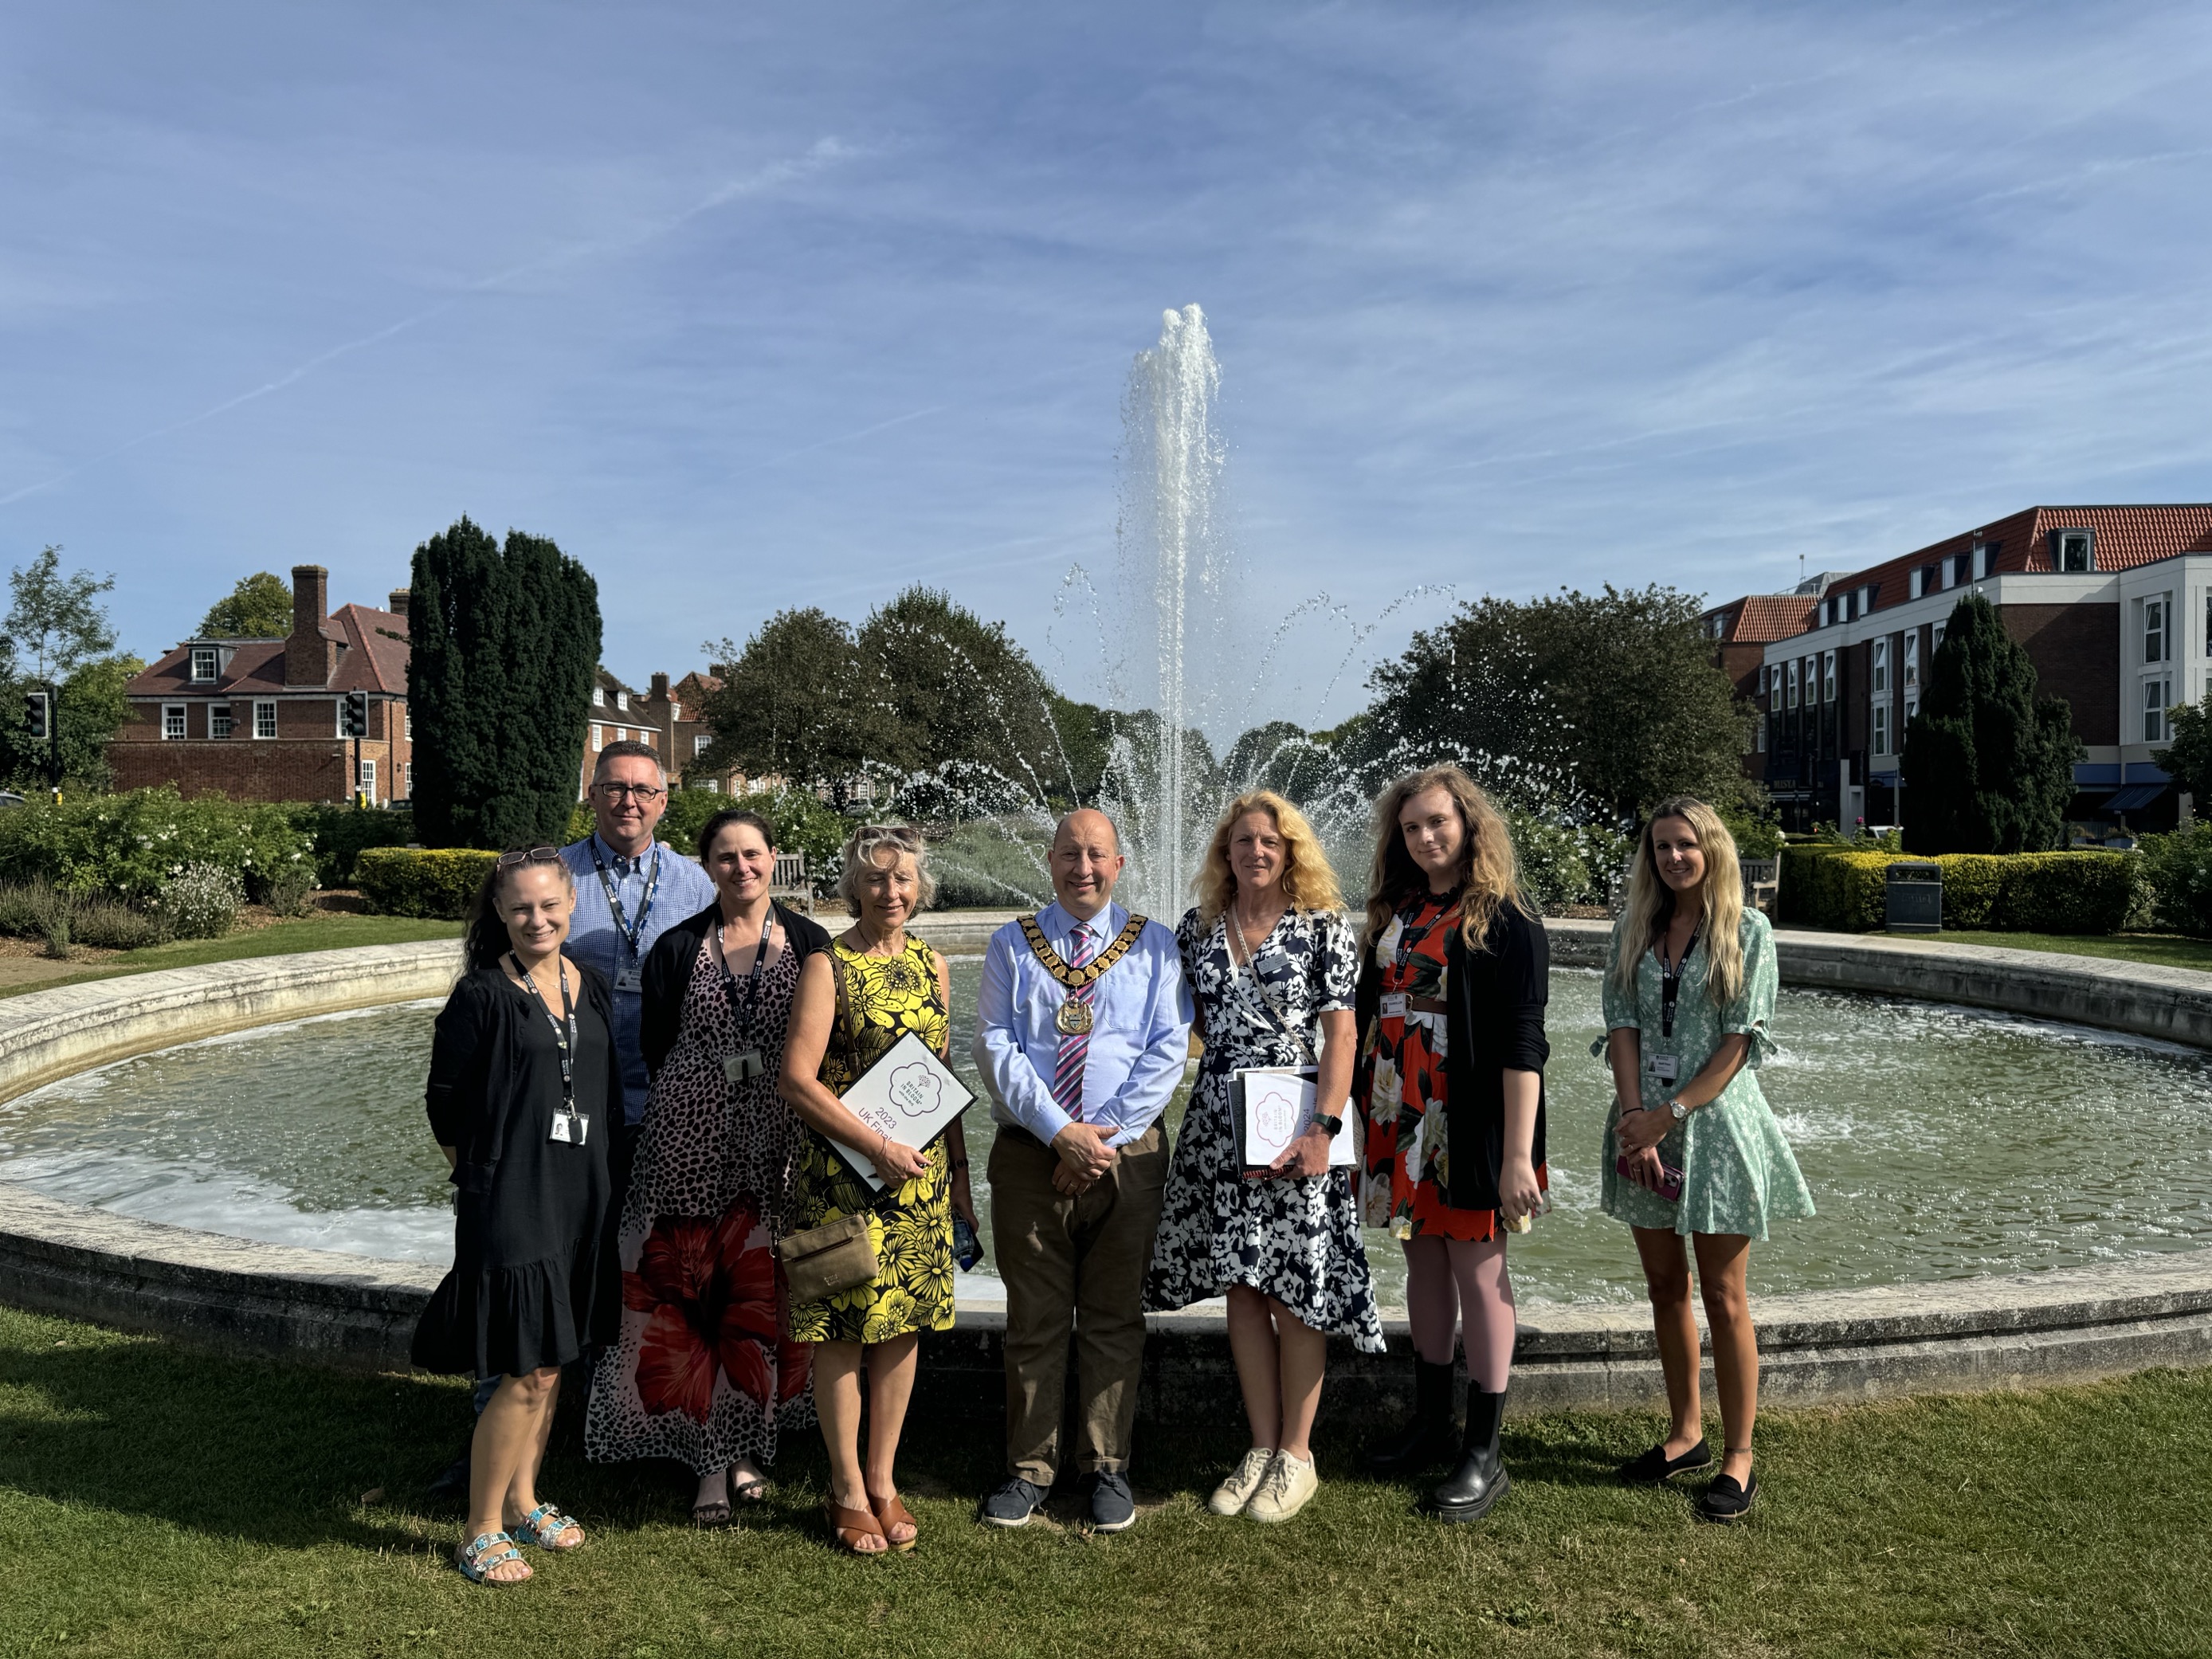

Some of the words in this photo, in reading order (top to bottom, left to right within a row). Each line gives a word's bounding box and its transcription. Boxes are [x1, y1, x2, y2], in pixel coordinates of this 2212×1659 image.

[906, 1081, 924, 1100] BRITAIN
[858, 1108, 873, 1124] UK
[875, 1107, 897, 1129] 2023
